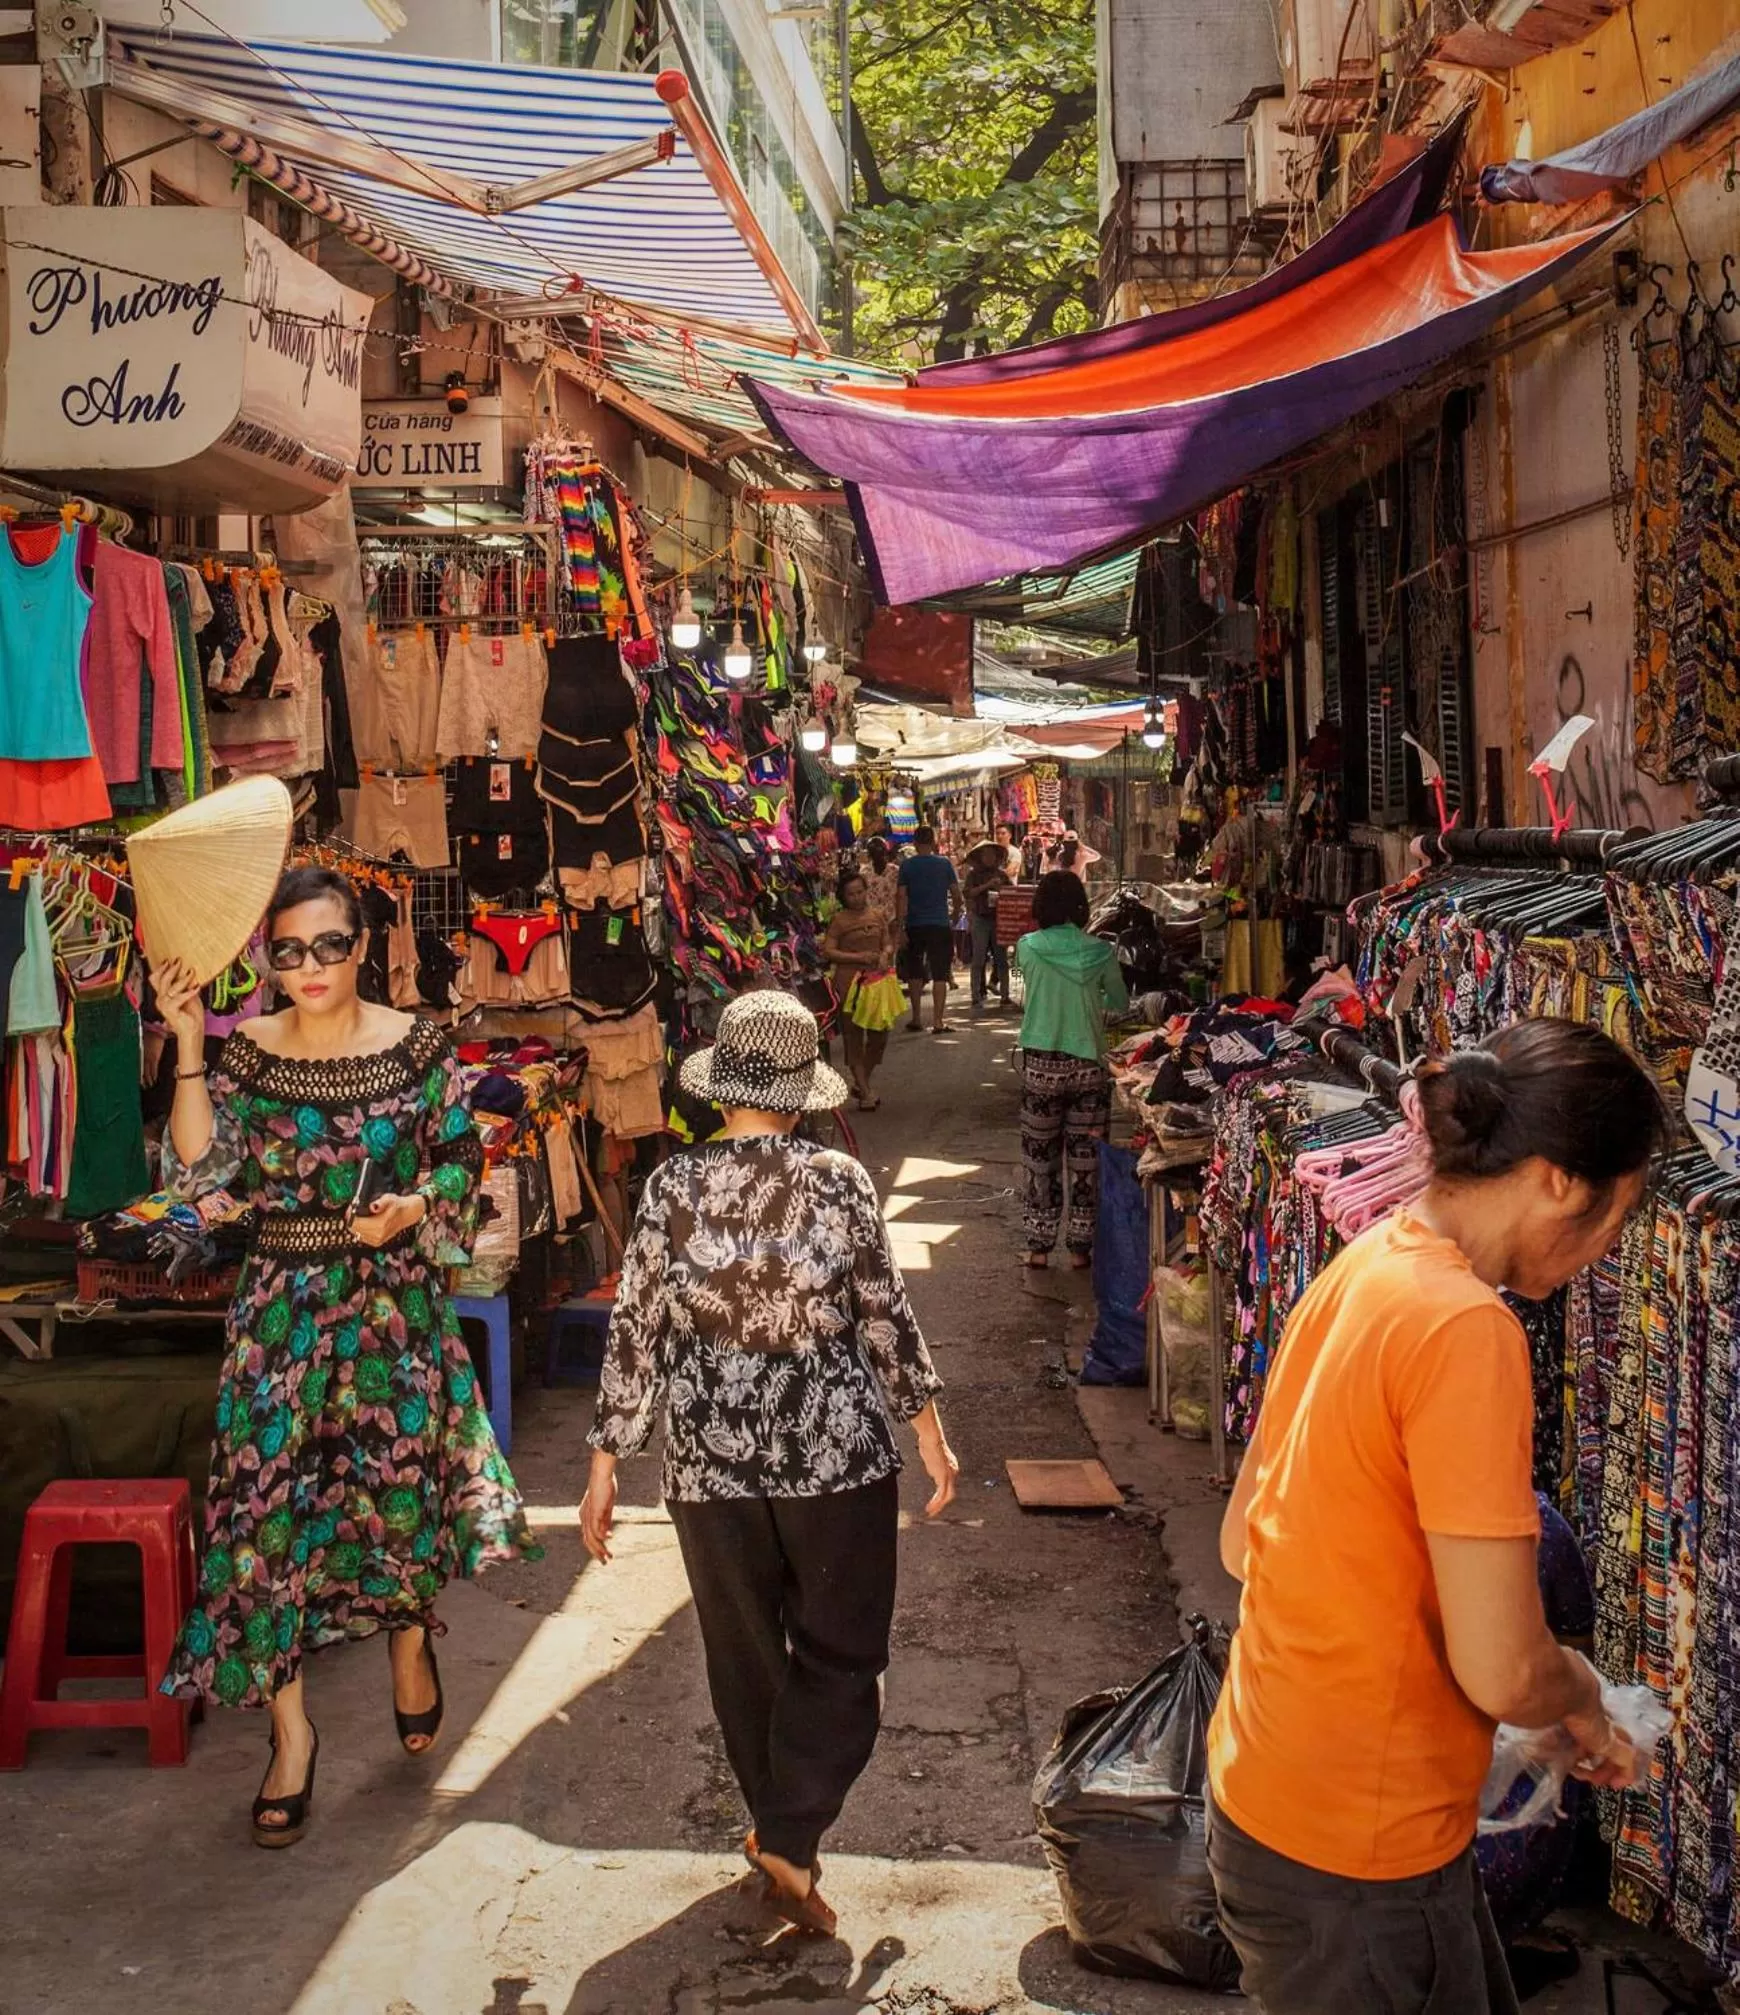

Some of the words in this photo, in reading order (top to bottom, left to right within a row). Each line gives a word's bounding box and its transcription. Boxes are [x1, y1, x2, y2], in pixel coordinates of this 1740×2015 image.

[26, 266, 225, 336] Phương
[321, 294, 359, 391] Anh
[61, 358, 186, 427] Anh
[401, 442, 482, 475] LINH
